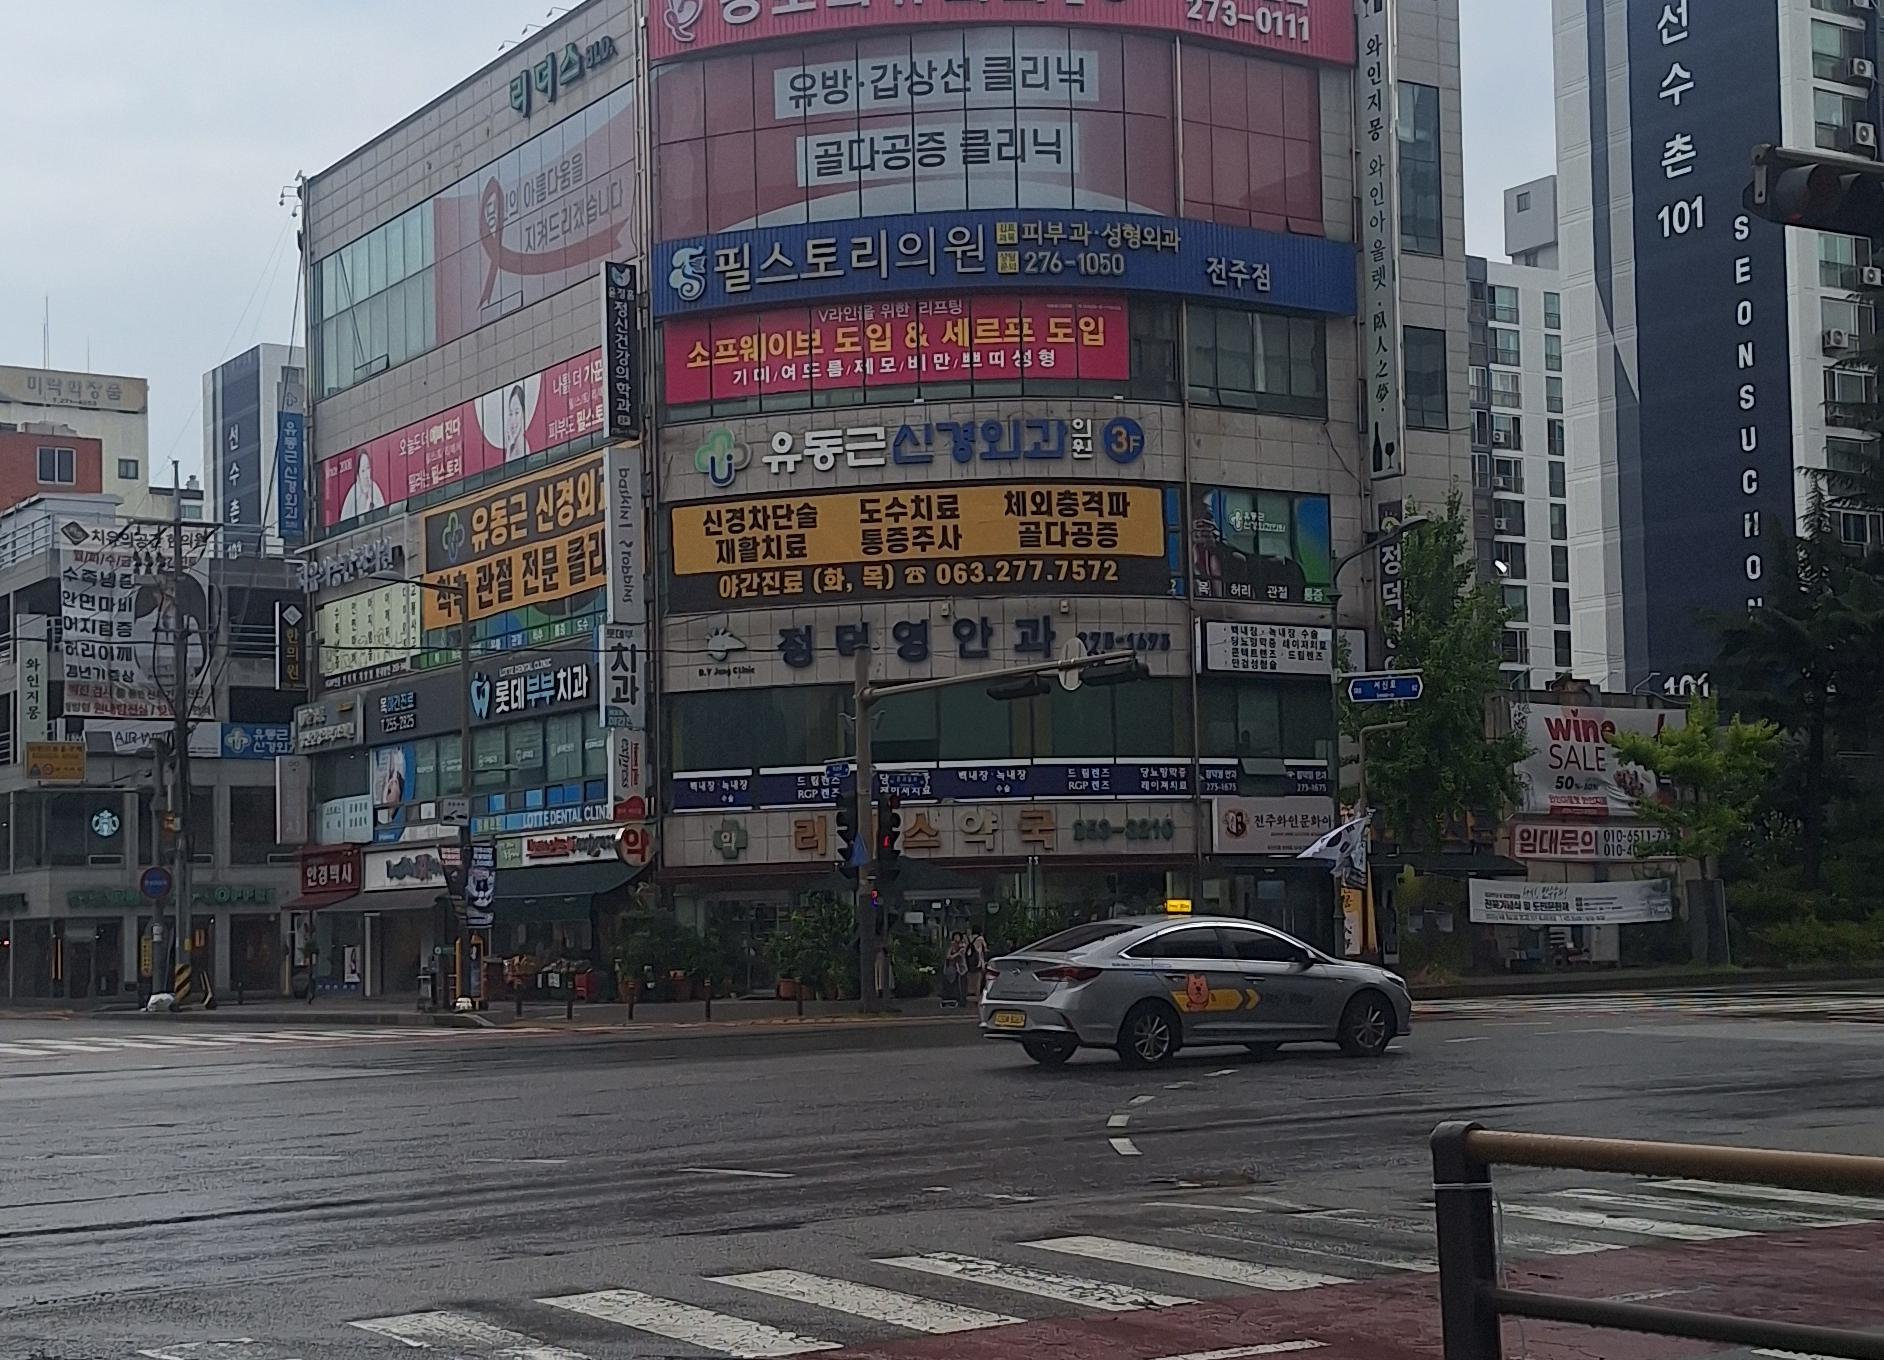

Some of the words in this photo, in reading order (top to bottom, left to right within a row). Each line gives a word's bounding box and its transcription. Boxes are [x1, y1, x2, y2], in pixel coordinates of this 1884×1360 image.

[509, 42, 585, 119] 리더스
[788, 56, 972, 110] 유방·갑상선
[982, 53, 1086, 94] 클리닉
[1365, 33, 1384, 143] 와인지몽
[813, 131, 946, 176] 골다공증
[959, 125, 1063, 166] 클리닉
[523, 151, 584, 209] 아름다움을
[524, 177, 624, 253] 지켜드리겠습니다
[1021, 219, 1182, 254] 피부과·성형외과
[1368, 154, 1387, 292] 와인아울렛
[1656, 194, 1705, 238] 101
[713, 223, 987, 294] 필스토리의원
[1024, 250, 1125, 276] 276-1050
[1206, 256, 1272, 292] 전주점
[880, 300, 909, 320] 위한
[918, 298, 964, 317] 리프팅
[686, 324, 824, 370] 소프웨이브
[833, 321, 893, 354] 도입
[903, 322, 930, 350] &
[941, 315, 1036, 349] 세르프
[1046, 315, 1106, 347] 도입
[575, 403, 605, 432] 필스토
[1110, 425, 1142, 455] 3F
[761, 426, 886, 474] 유동근
[892, 417, 1069, 465] 신경외과
[228, 423, 241, 525] 선수촌
[471, 491, 529, 554] 유동근
[703, 501, 819, 537] 신경차단술
[859, 494, 961, 525] 도수치료
[1004, 489, 1131, 519] 체외충격파
[715, 532, 808, 566] 재활치료
[860, 523, 963, 556] 통증주사
[1018, 520, 1119, 549] 골다공증
[476, 556, 513, 610] 관절
[522, 544, 559, 597] 전문
[567, 526, 606, 587] 클리
[719, 569, 804, 600] 야간진료
[935, 559, 1120, 586] 063.277.7572
[62, 590, 133, 613] 안면마비
[63, 615, 133, 638] 어지럼증
[26, 657, 41, 721] 와인지몽
[610, 642, 640, 706] 치과
[1544, 708, 1616, 745] wine
[1548, 744, 1607, 772] SALE
[796, 788, 819, 800] RGP
[1067, 780, 1089, 791] RGP
[521, 809, 549, 829] LOTTE
[549, 806, 583, 826] DENTAL
[583, 803, 609, 821] CLINI
[793, 806, 1056, 857] 리스약국
[1519, 828, 1599, 857] 임대문의
